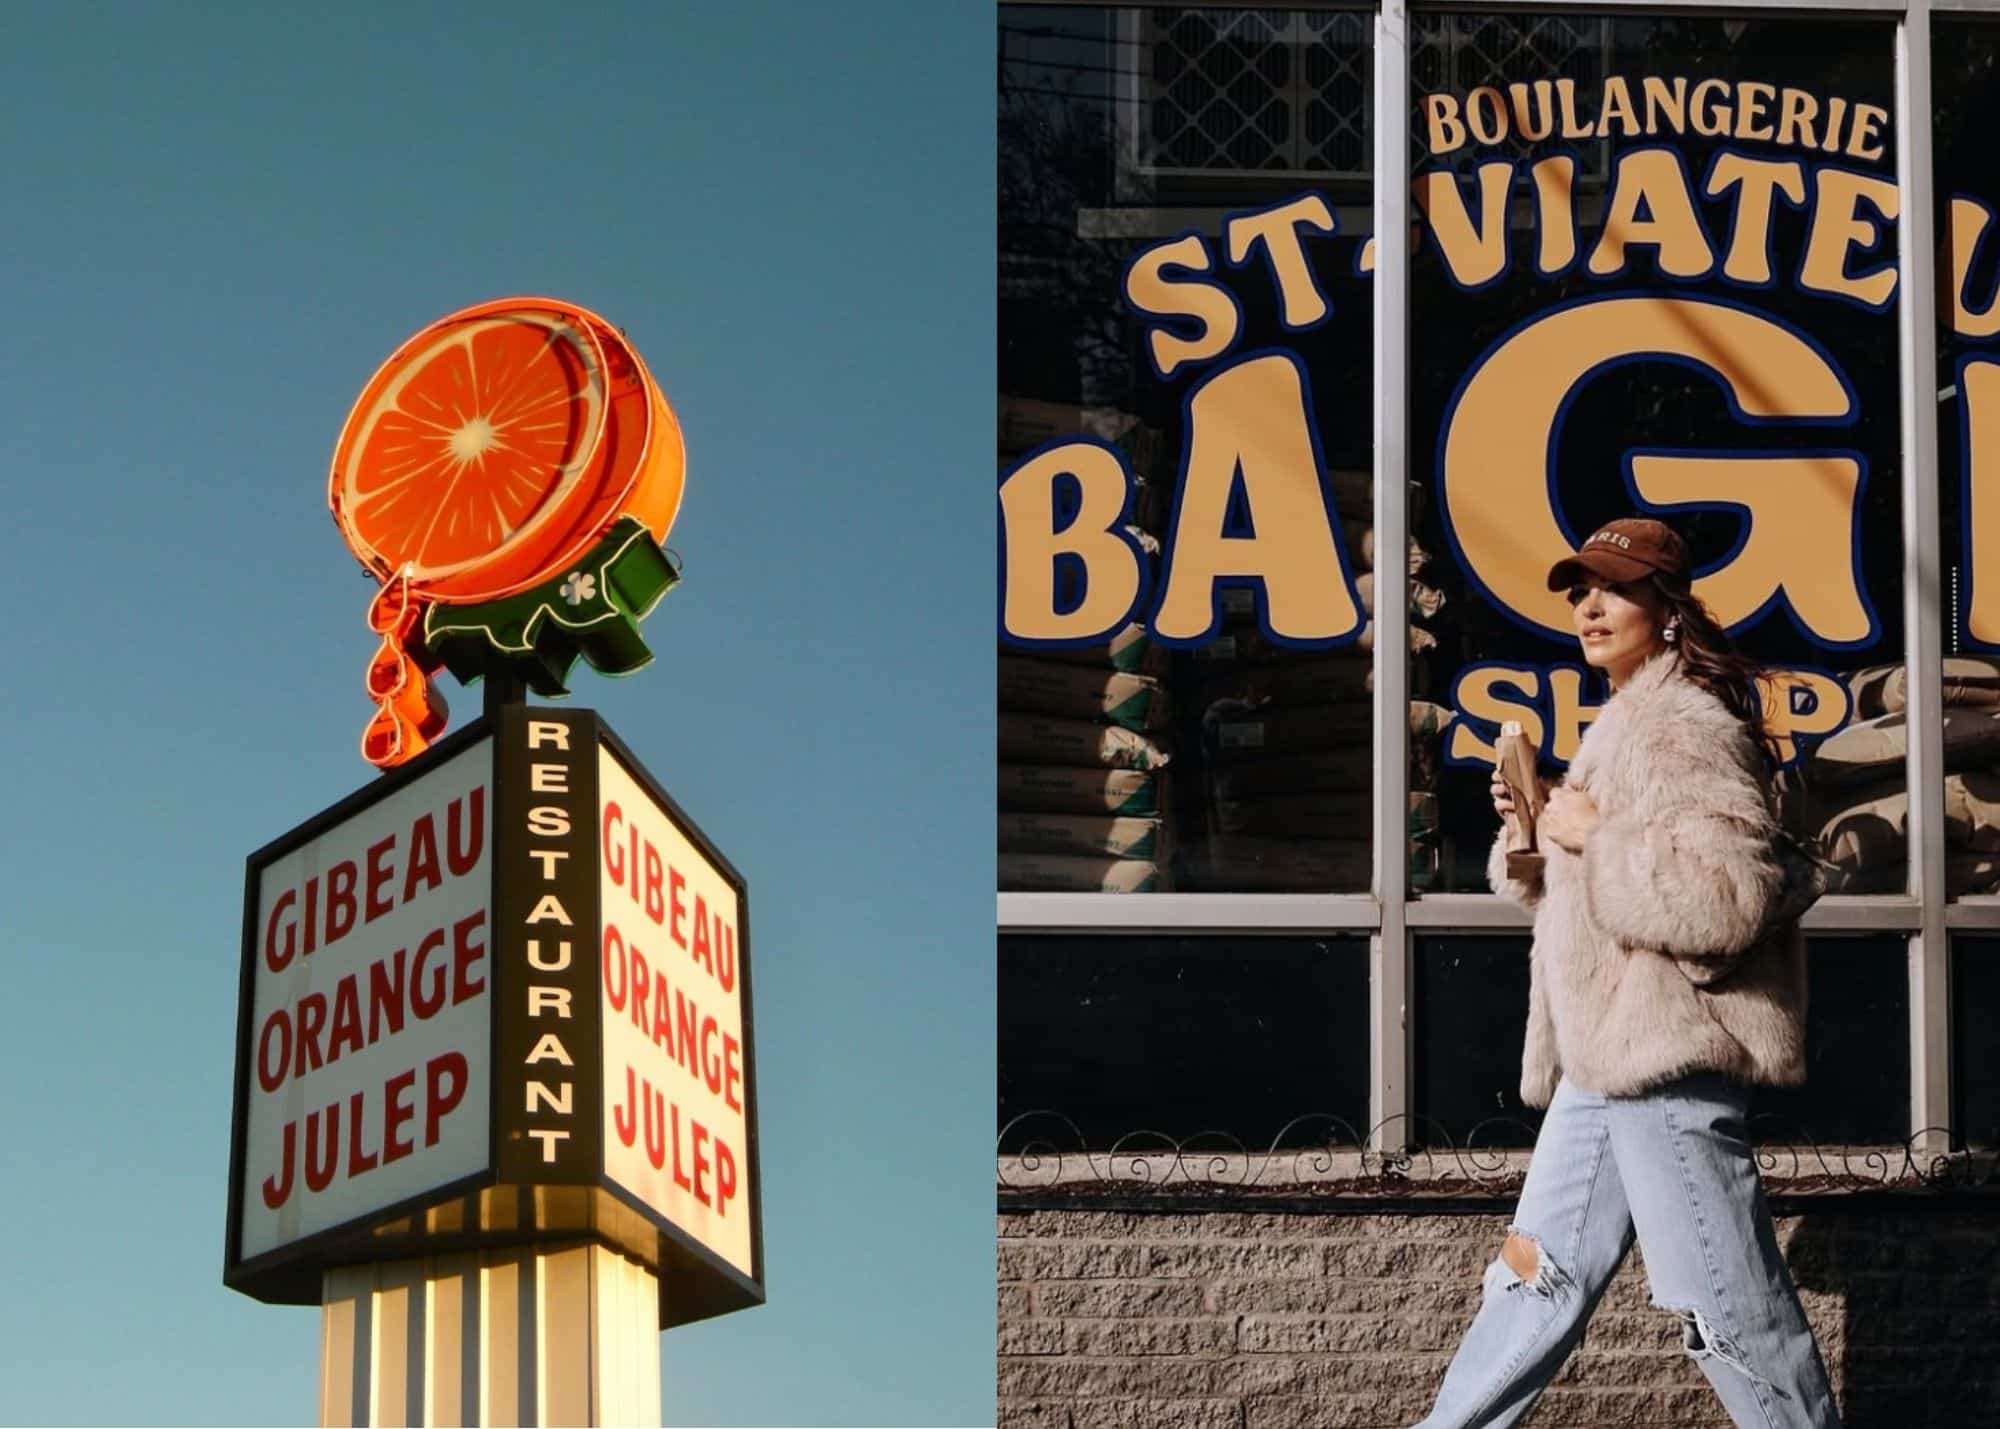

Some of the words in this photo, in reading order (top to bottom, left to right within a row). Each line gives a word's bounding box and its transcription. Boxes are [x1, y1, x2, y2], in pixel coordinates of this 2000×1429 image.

[1425, 75, 1888, 161] BOULANGERIE
[1451, 666, 1848, 762] SHP
[265, 784, 485, 973] GIBEAU
[525, 720, 574, 1163] RESTAURANT
[602, 800, 735, 993] GIBEAU
[257, 908, 486, 1093] ORANGE
[602, 924, 742, 1115] ORANGE
[262, 1051, 469, 1210] JULEP
[613, 1065, 737, 1217] JULEP
